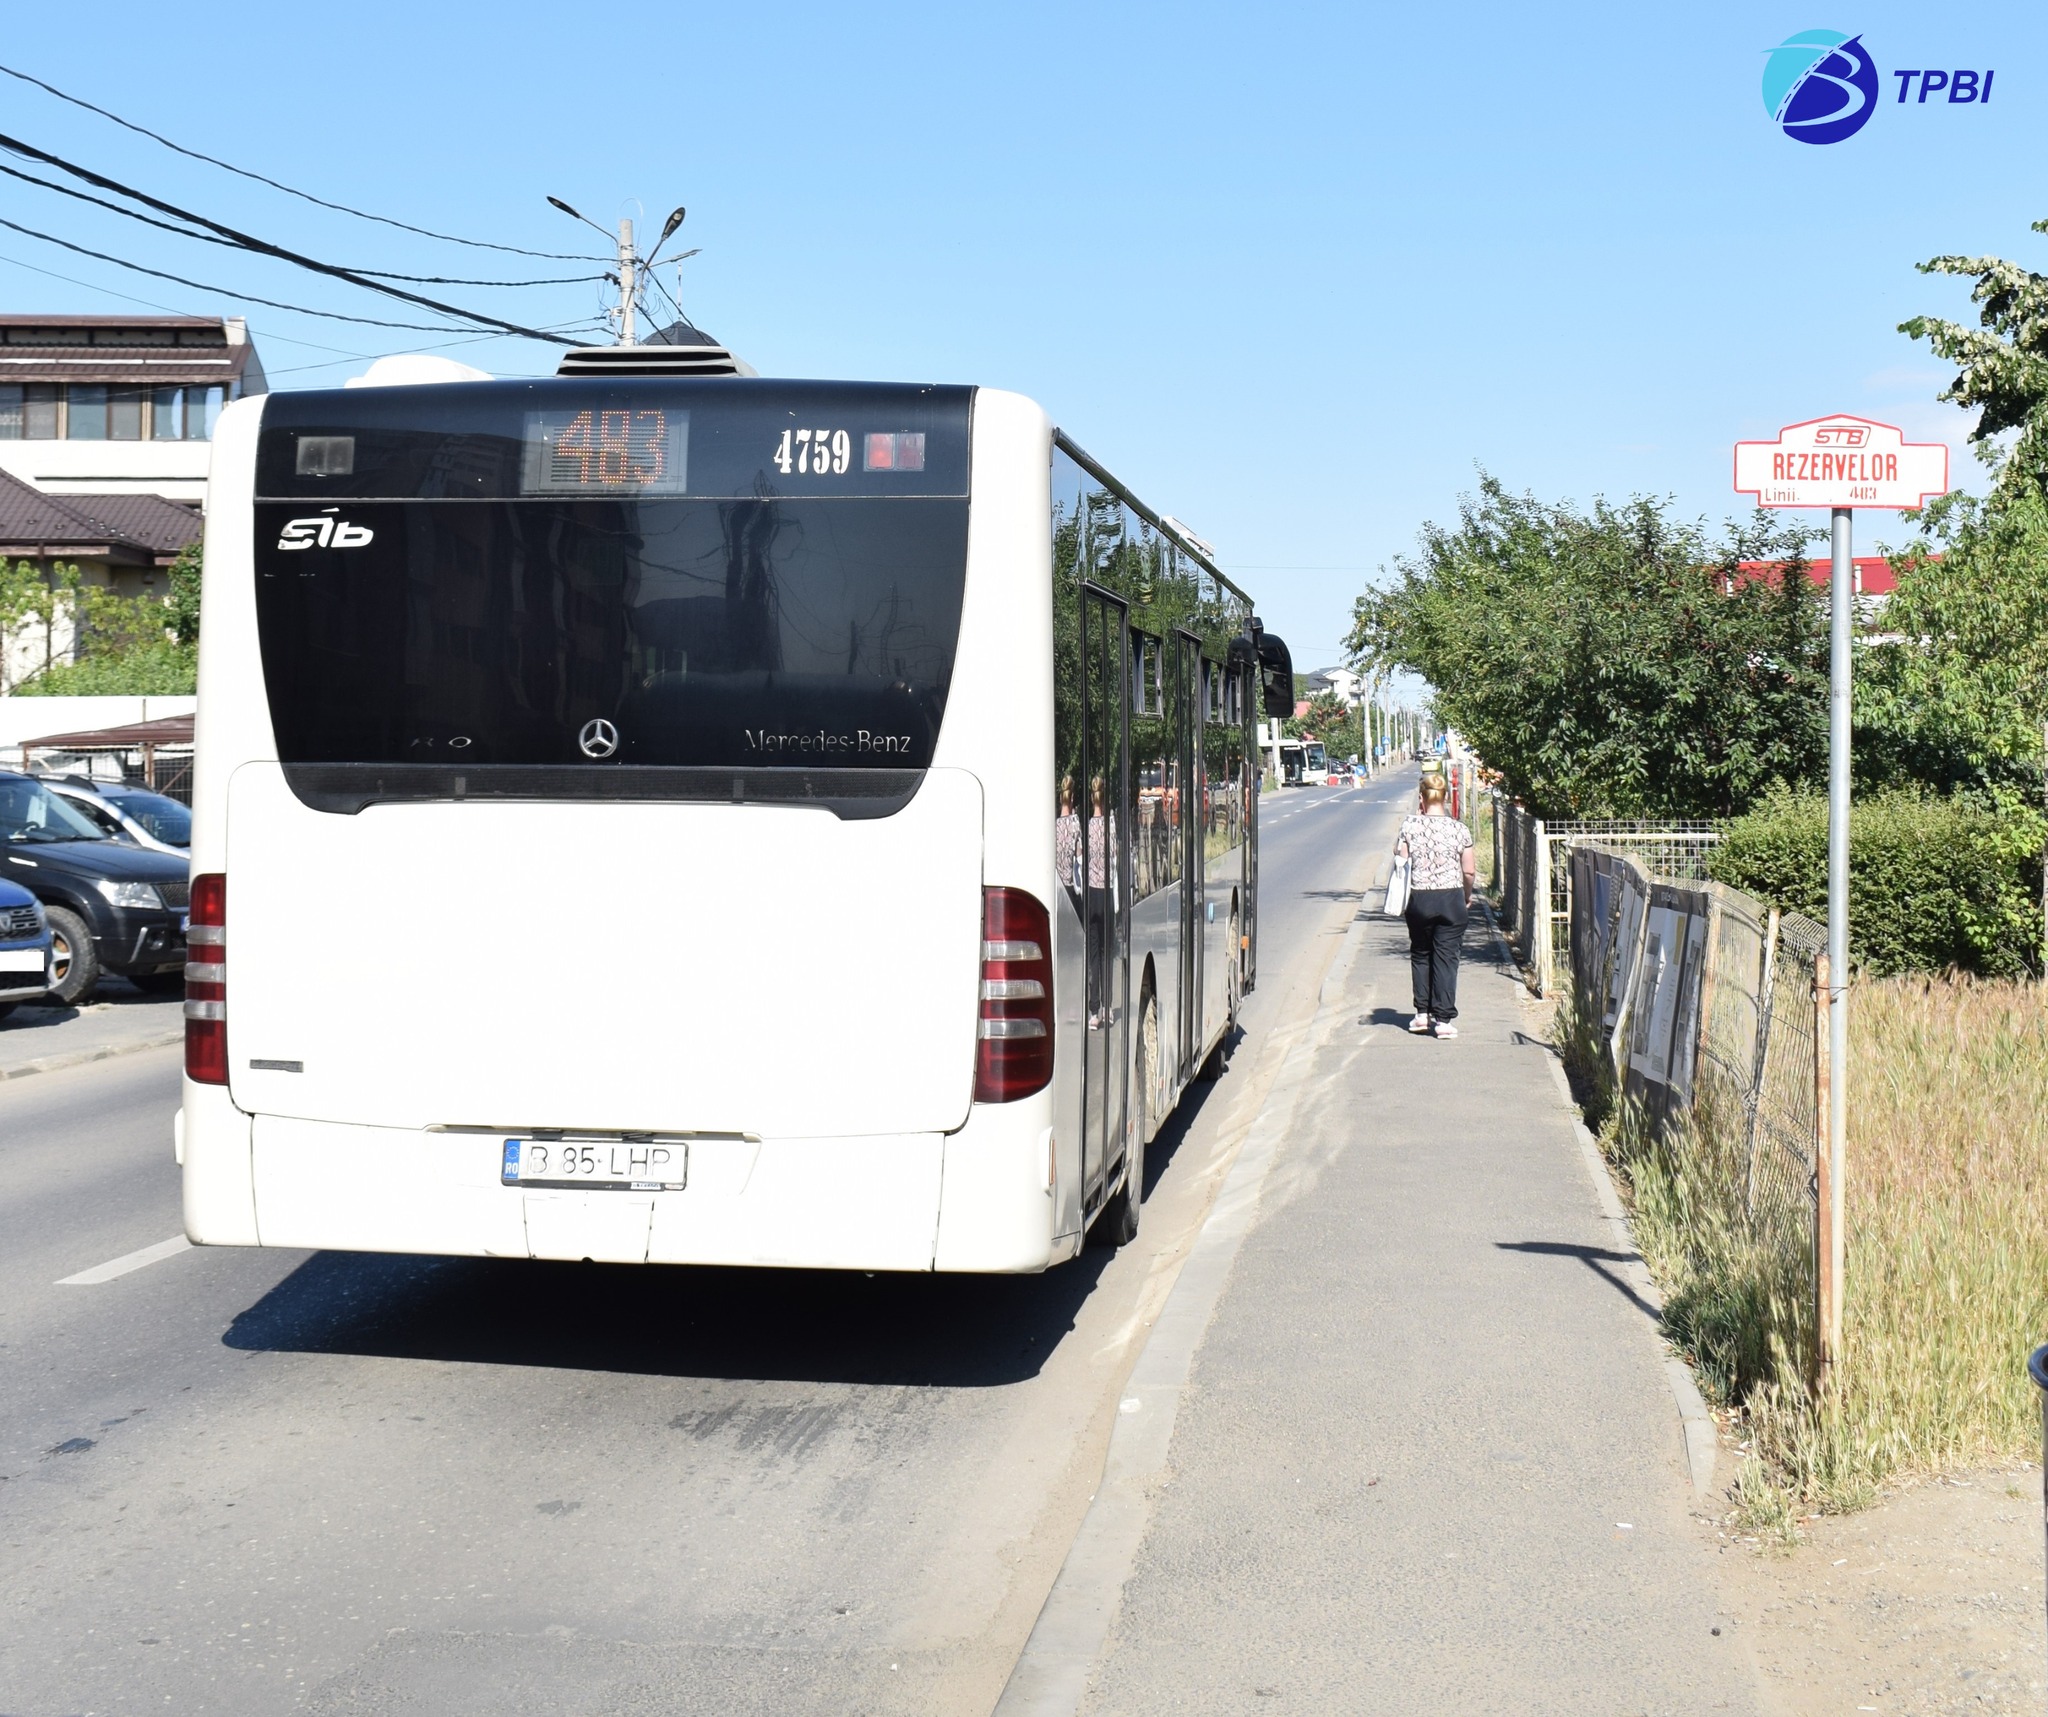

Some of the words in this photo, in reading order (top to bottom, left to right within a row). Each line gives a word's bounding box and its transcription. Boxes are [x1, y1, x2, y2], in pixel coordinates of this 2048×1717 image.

[558, 410, 665, 485] 483
[773, 428, 851, 475] 4759
[1814, 428, 1864, 445] STB
[1773, 452, 1898, 482] REZERVELOR
[744, 729, 911, 753] Mercedes-Benz
[505, 1161, 519, 1175] RO
[530, 1145, 548, 1174] B
[562, 1146, 595, 1175] 85
[611, 1147, 671, 1176] LHP
